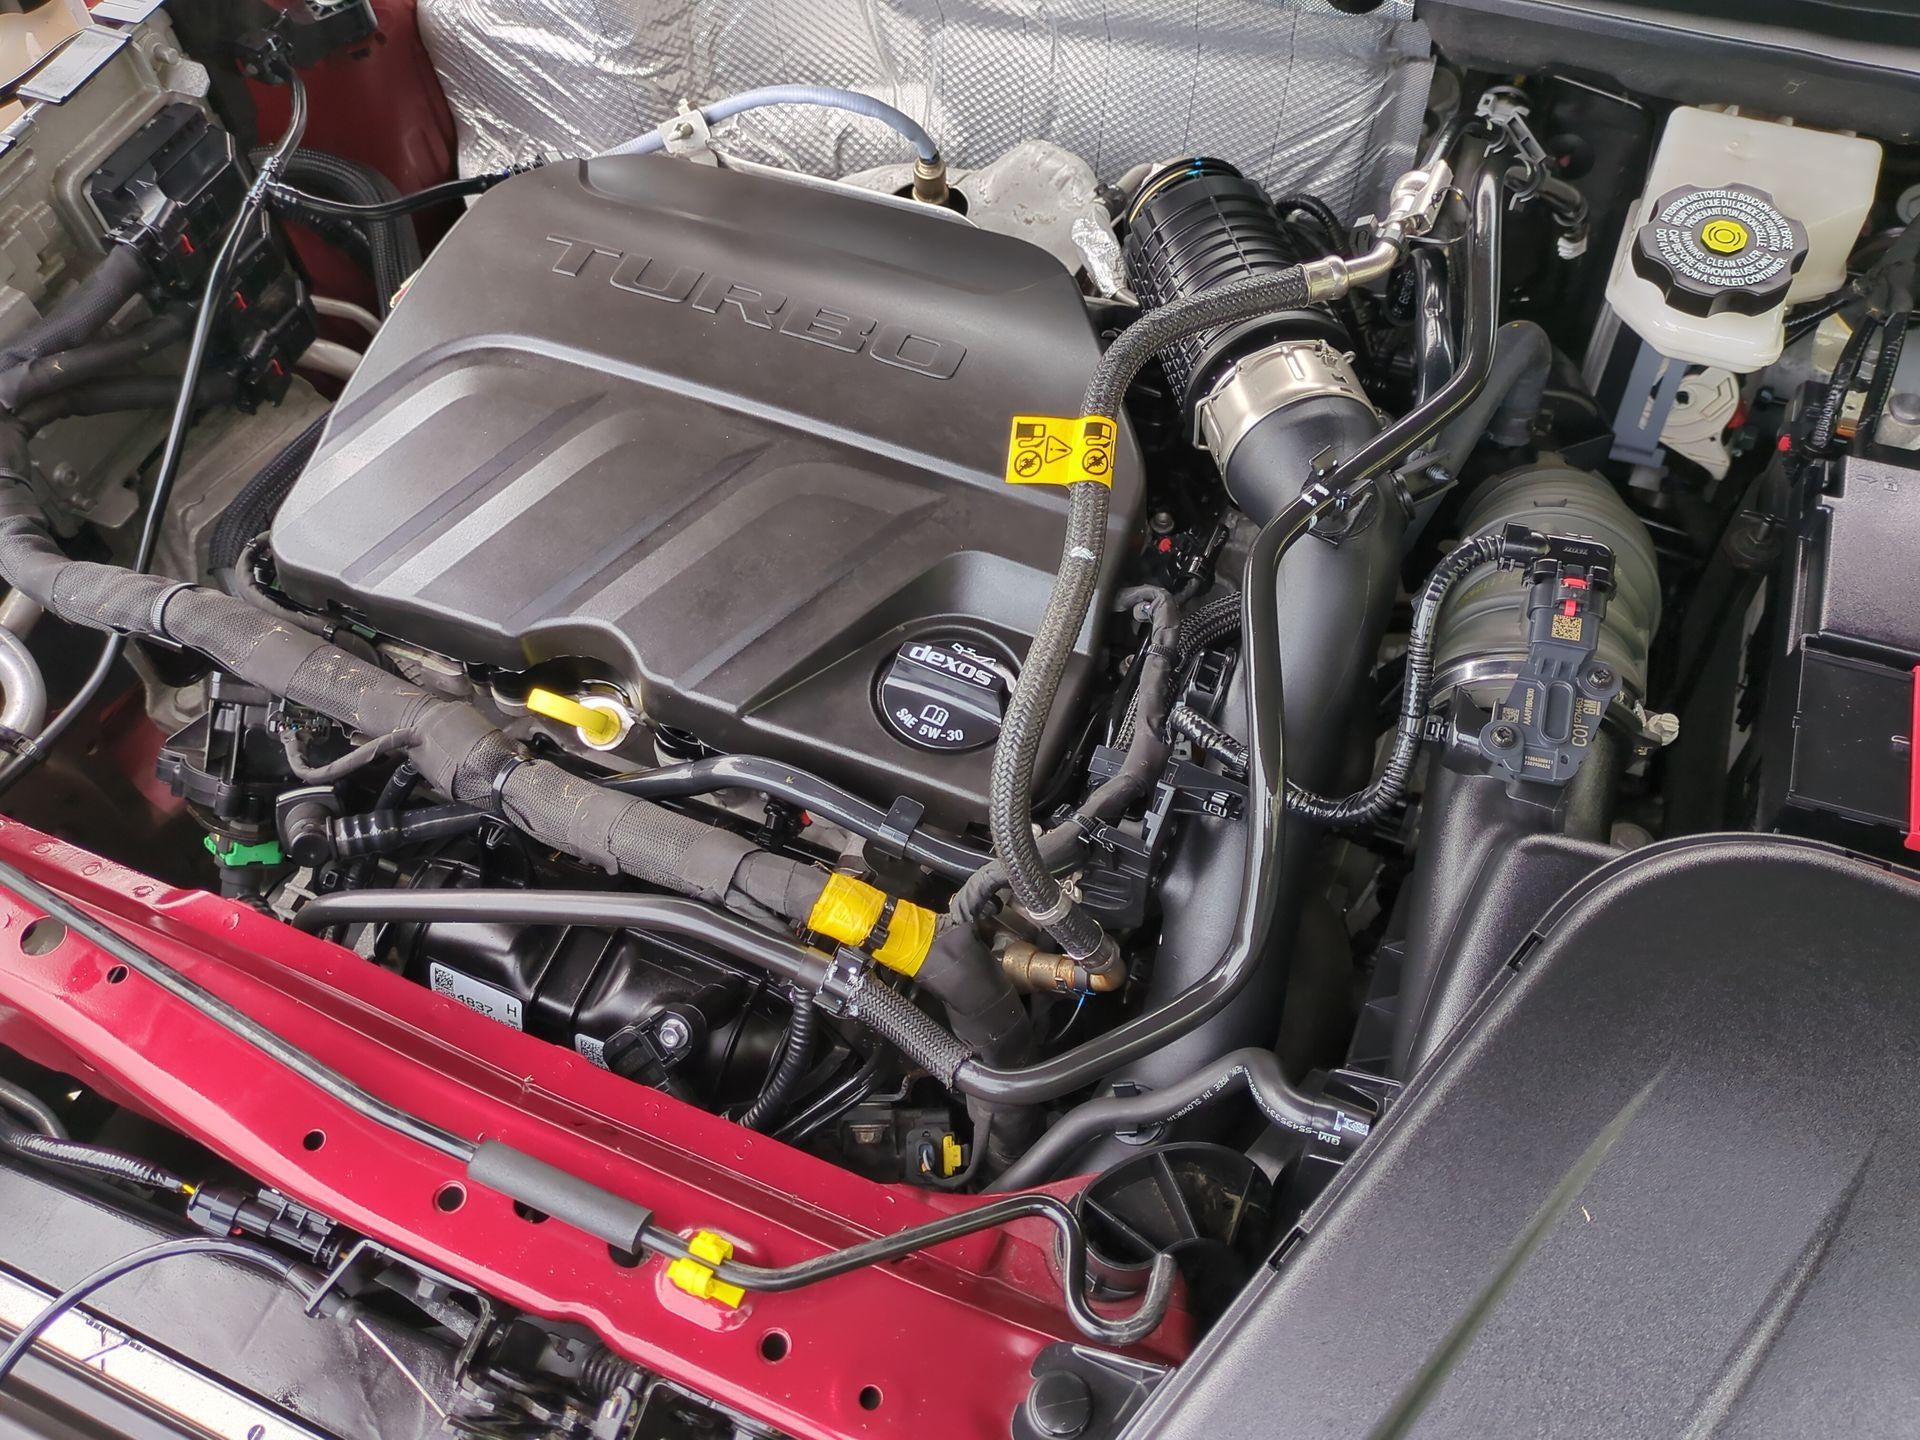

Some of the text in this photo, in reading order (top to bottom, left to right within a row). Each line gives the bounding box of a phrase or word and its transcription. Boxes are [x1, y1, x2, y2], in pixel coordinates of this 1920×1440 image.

[1688, 190, 1726, 203] NETTOYER
[1727, 191, 1738, 199] LE
[1738, 193, 1772, 214] BOUCHON
[1768, 210, 1788, 227] AVANT
[1705, 198, 1721, 207] QUE
[1721, 199, 1732, 207] DU
[1732, 200, 1760, 217] LIQUIDE
[1684, 207, 1721, 228] PROVENANT
[1756, 213, 1769, 221] DE
[1669, 229, 1681, 243] CAP
[1762, 220, 1779, 236] FREIN
[1671, 243, 1697, 267] BEFORE
[1706, 256, 1736, 268] CLEAN
[1736, 249, 1764, 267] FILLER
[1756, 253, 1774, 270] ONLY
[1660, 246, 1680, 265] FLUID
[1676, 263, 1703, 280] FROM
[1699, 274, 1708, 283] A
[1708, 276, 1745, 287] SEALED
[1740, 264, 1759, 276] USE
[546, 233, 968, 380] TURBO
[1583, 699, 1600, 716] GM
[896, 708, 964, 742] SAE 5W-30
[506, 1003, 517, 1017] H
